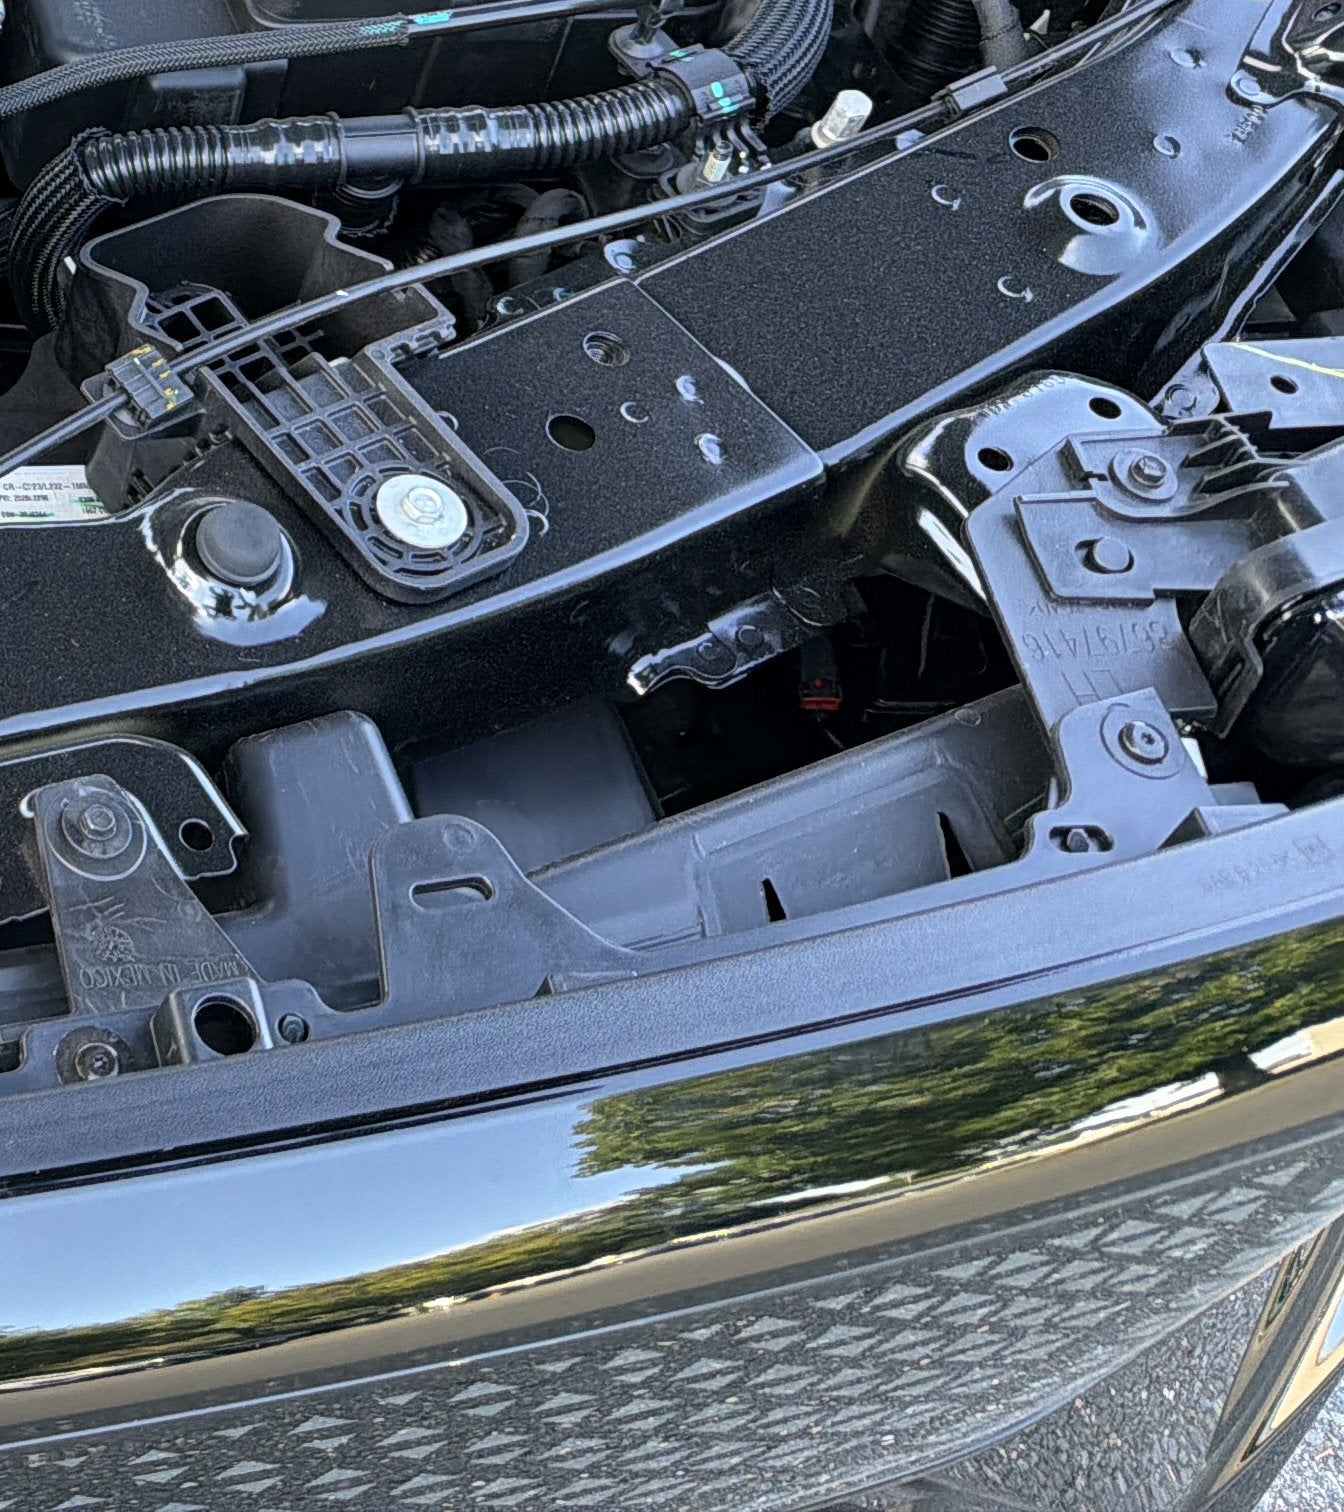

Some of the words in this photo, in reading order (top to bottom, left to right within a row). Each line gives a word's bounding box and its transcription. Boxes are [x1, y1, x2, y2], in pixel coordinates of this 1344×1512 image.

[80, 964, 152, 988] MEXICO
[160, 963, 181, 985] IN
[186, 958, 239, 982] MADE
